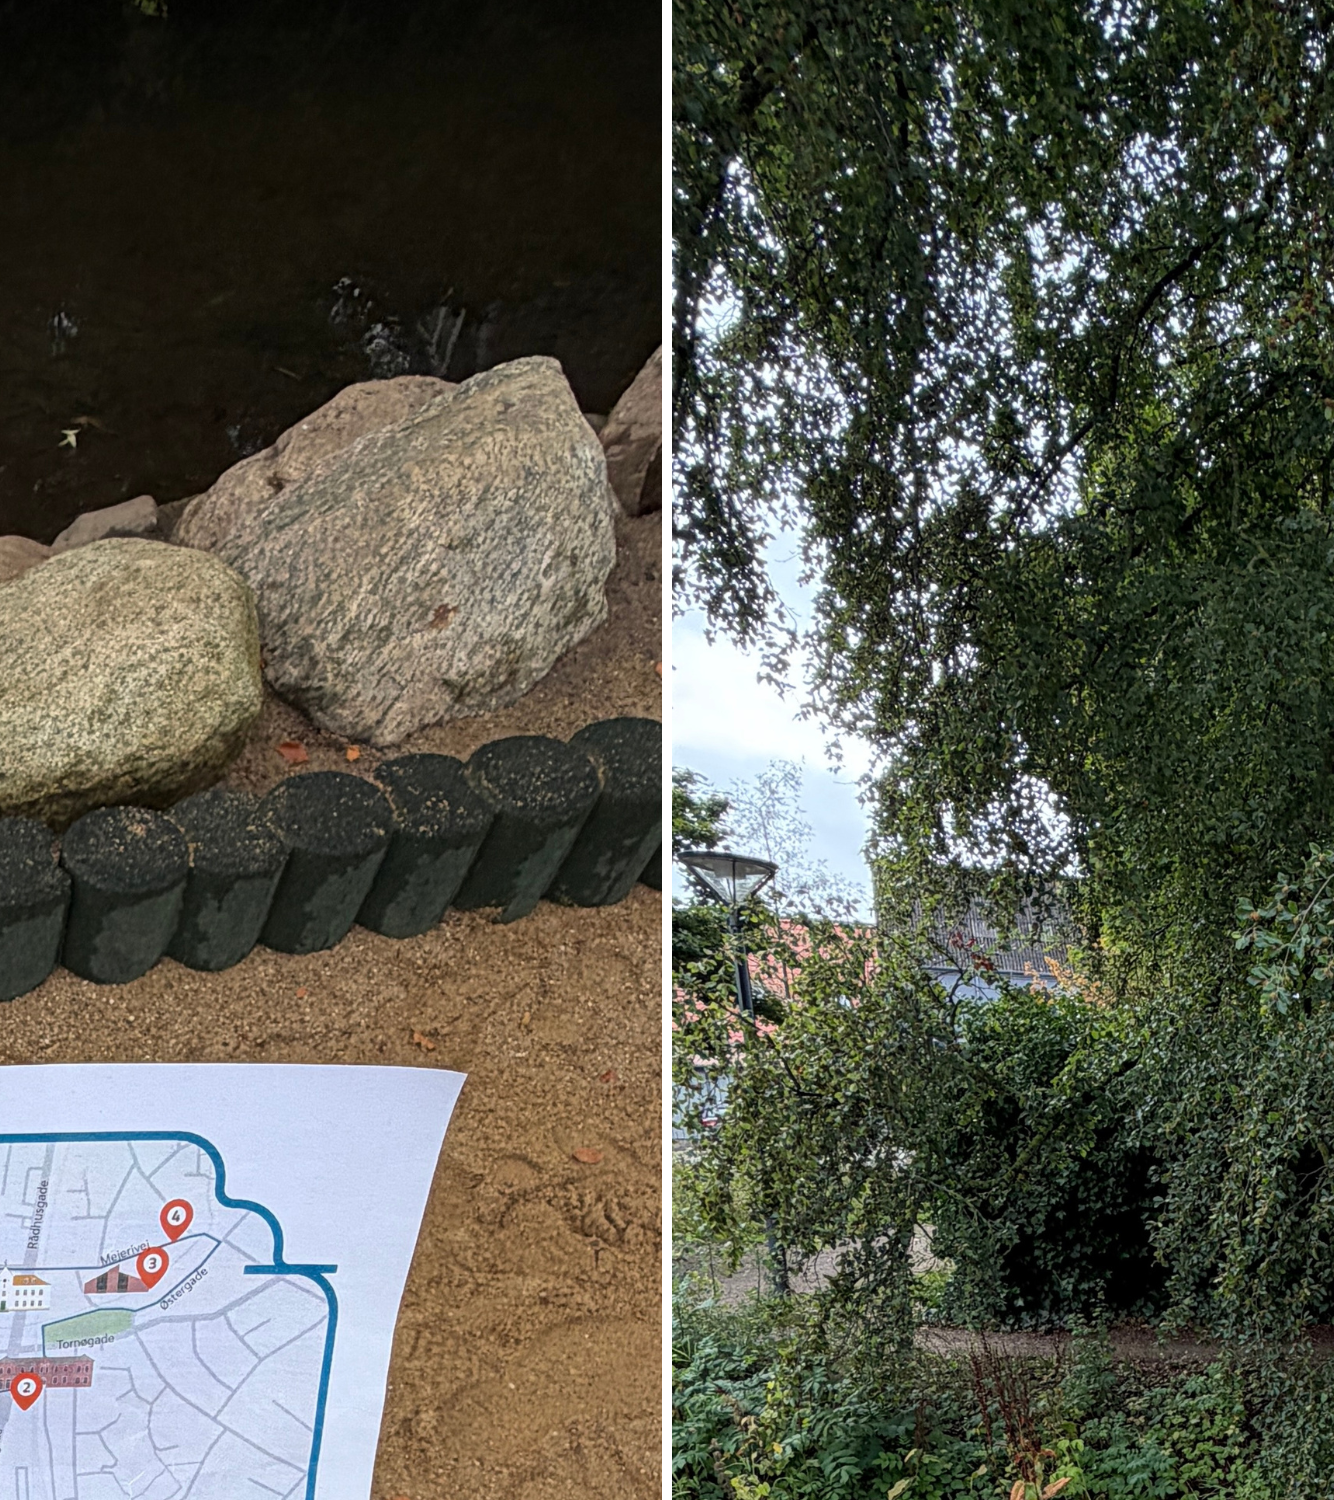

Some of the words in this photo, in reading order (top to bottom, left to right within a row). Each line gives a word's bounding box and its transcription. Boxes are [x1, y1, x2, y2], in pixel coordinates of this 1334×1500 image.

[27, 1180, 49, 1250] Rådhusgade
[171, 1210, 181, 1222] 4
[100, 1240, 150, 1266] Mejerivej
[149, 1258, 157, 1269] 3
[160, 1267, 209, 1311] Østergade
[56, 1334, 115, 1350] Tornøgade
[22, 1382, 31, 1394] 2
